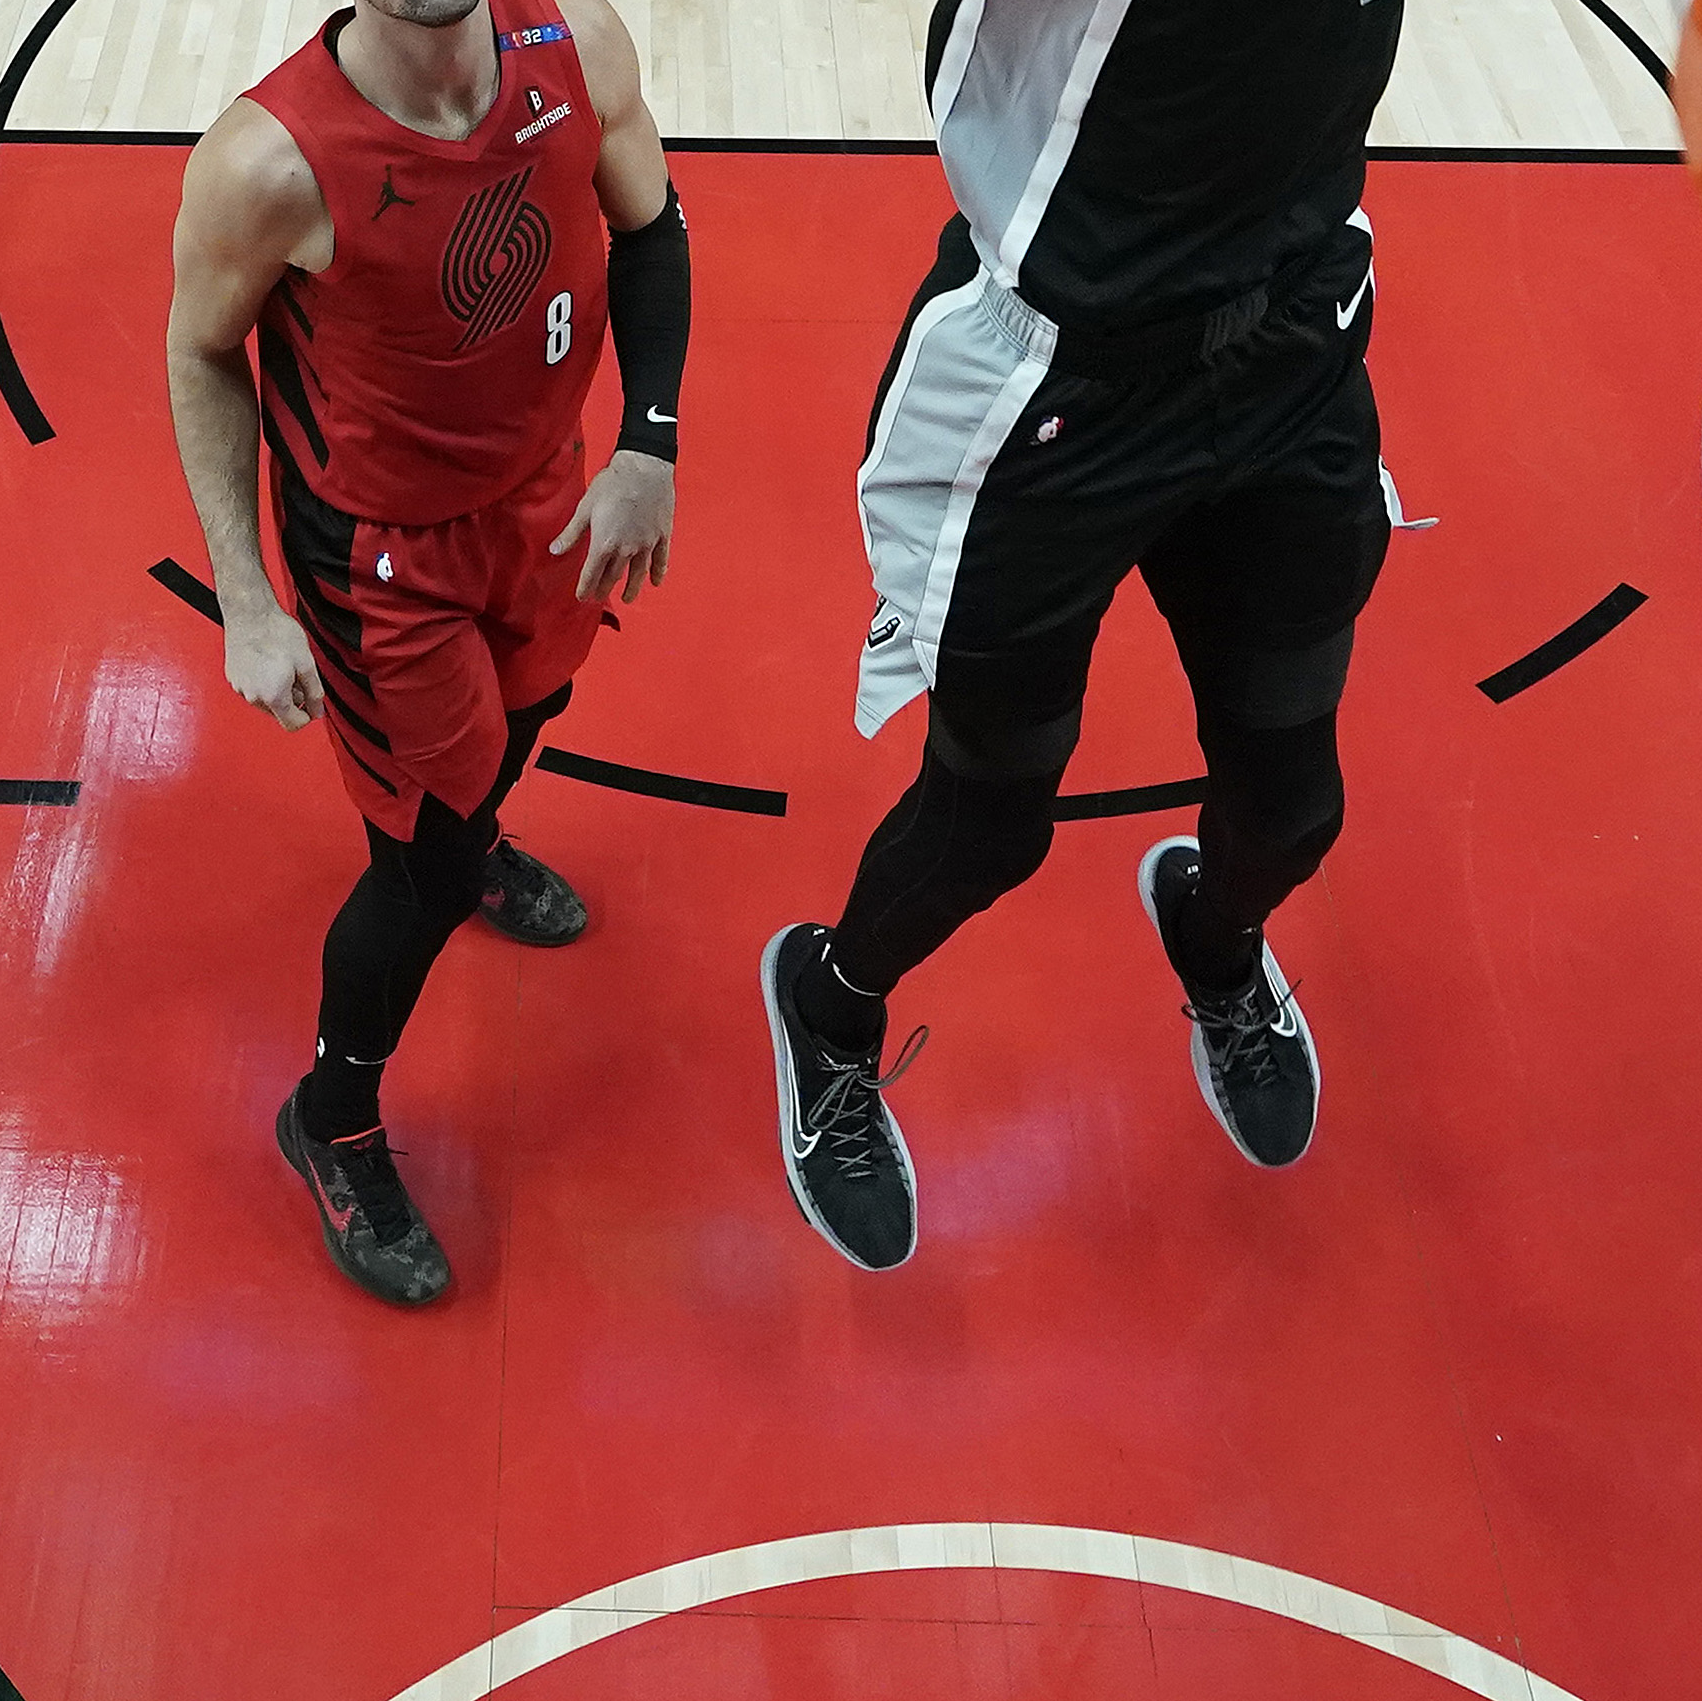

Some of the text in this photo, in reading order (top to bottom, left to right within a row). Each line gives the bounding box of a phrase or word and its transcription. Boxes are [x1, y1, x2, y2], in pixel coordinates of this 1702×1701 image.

[521, 28, 543, 46] 32
[514, 102, 573, 145] BRIGHTSIDE
[545, 290, 573, 366] 8
